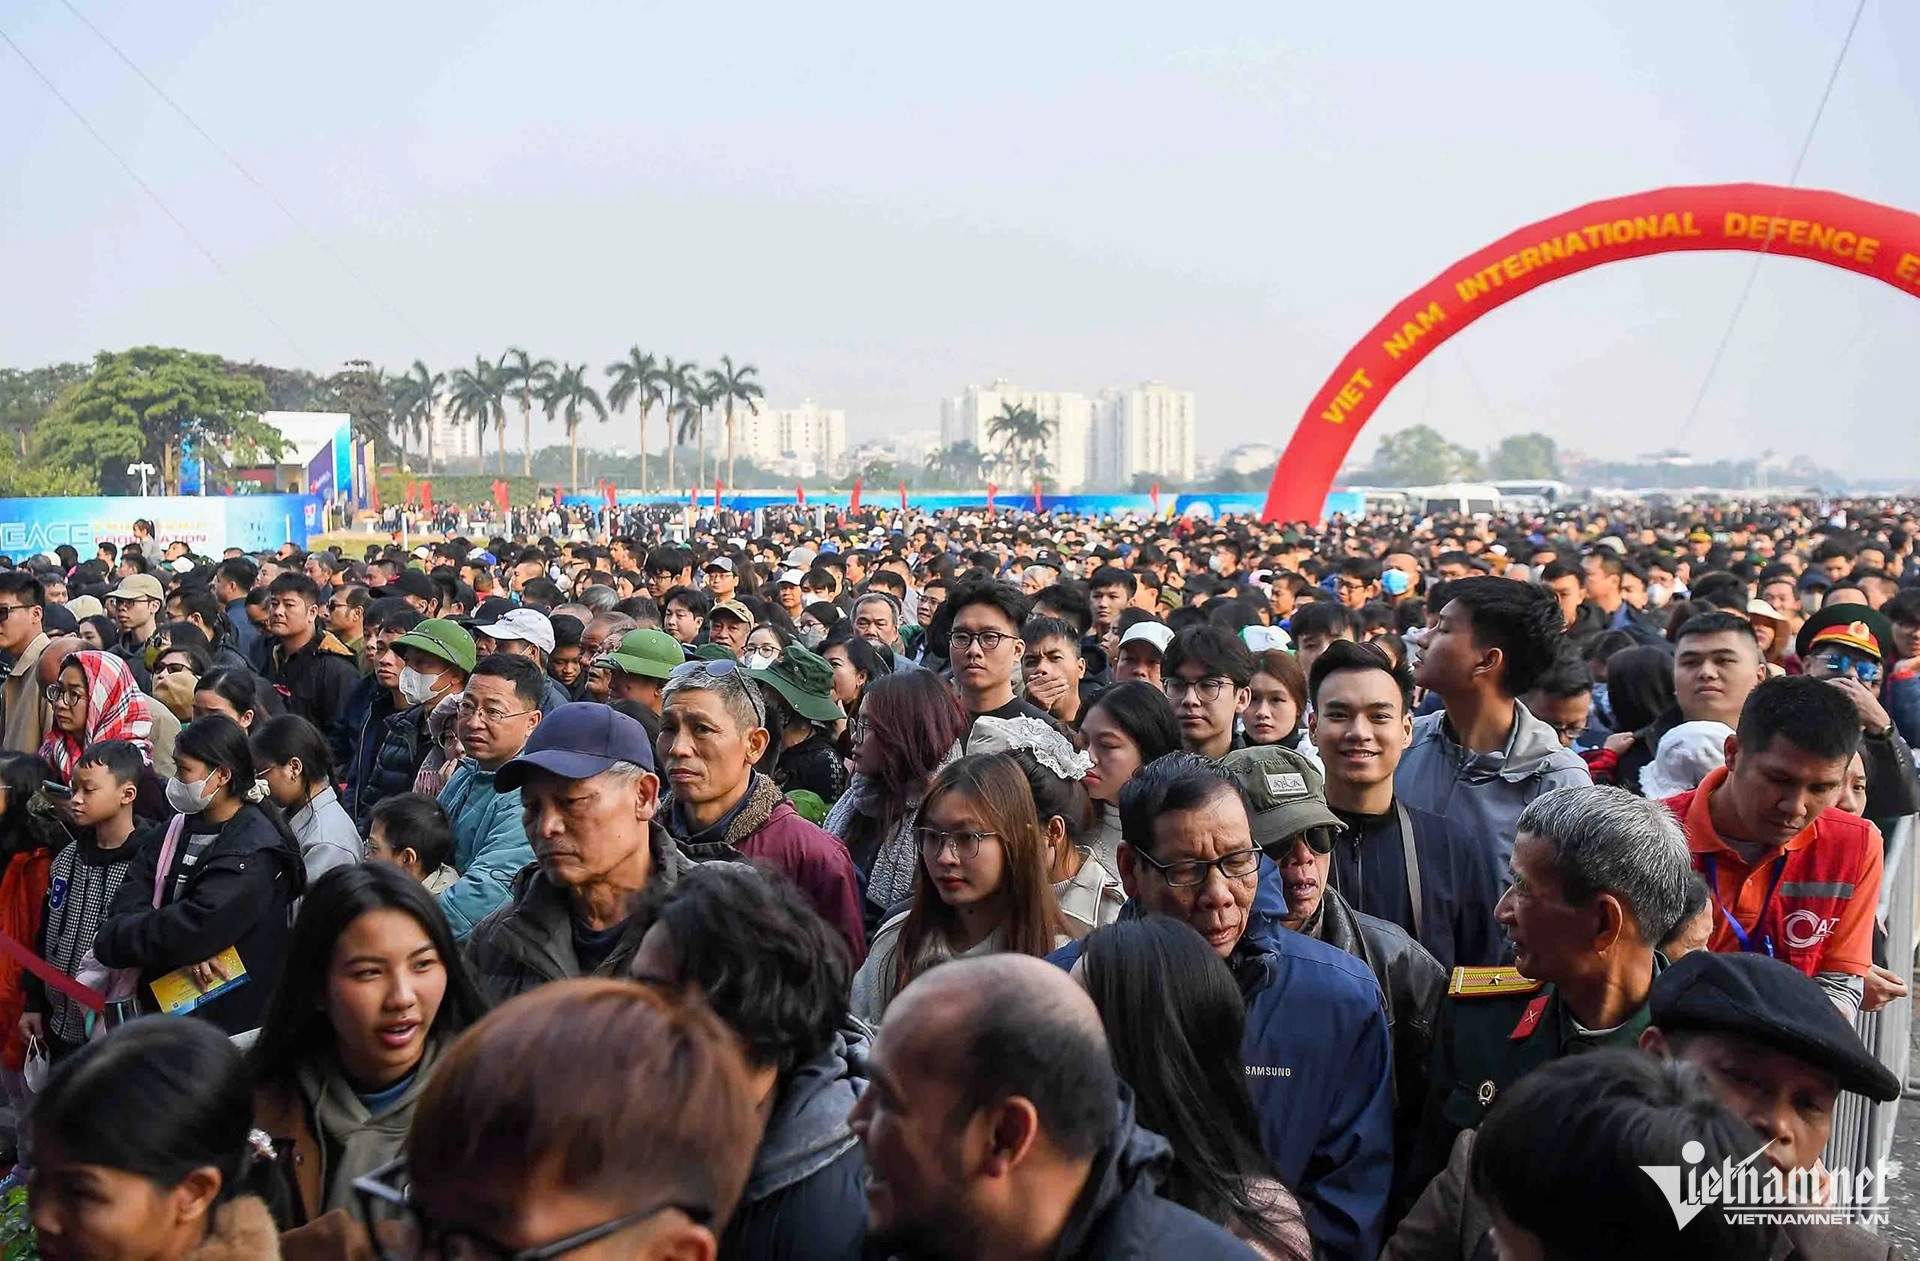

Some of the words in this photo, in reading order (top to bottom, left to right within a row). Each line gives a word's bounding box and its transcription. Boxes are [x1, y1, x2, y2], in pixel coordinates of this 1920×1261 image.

[1321, 367, 1373, 424] VIET
[1383, 301, 1447, 359] NAM
[1456, 211, 1702, 302] INTERNATIONAL
[1725, 211, 1880, 263] DEFENCE
[1896, 253, 1920, 281] E
[1245, 1065, 1291, 1077] SAMSUNG
